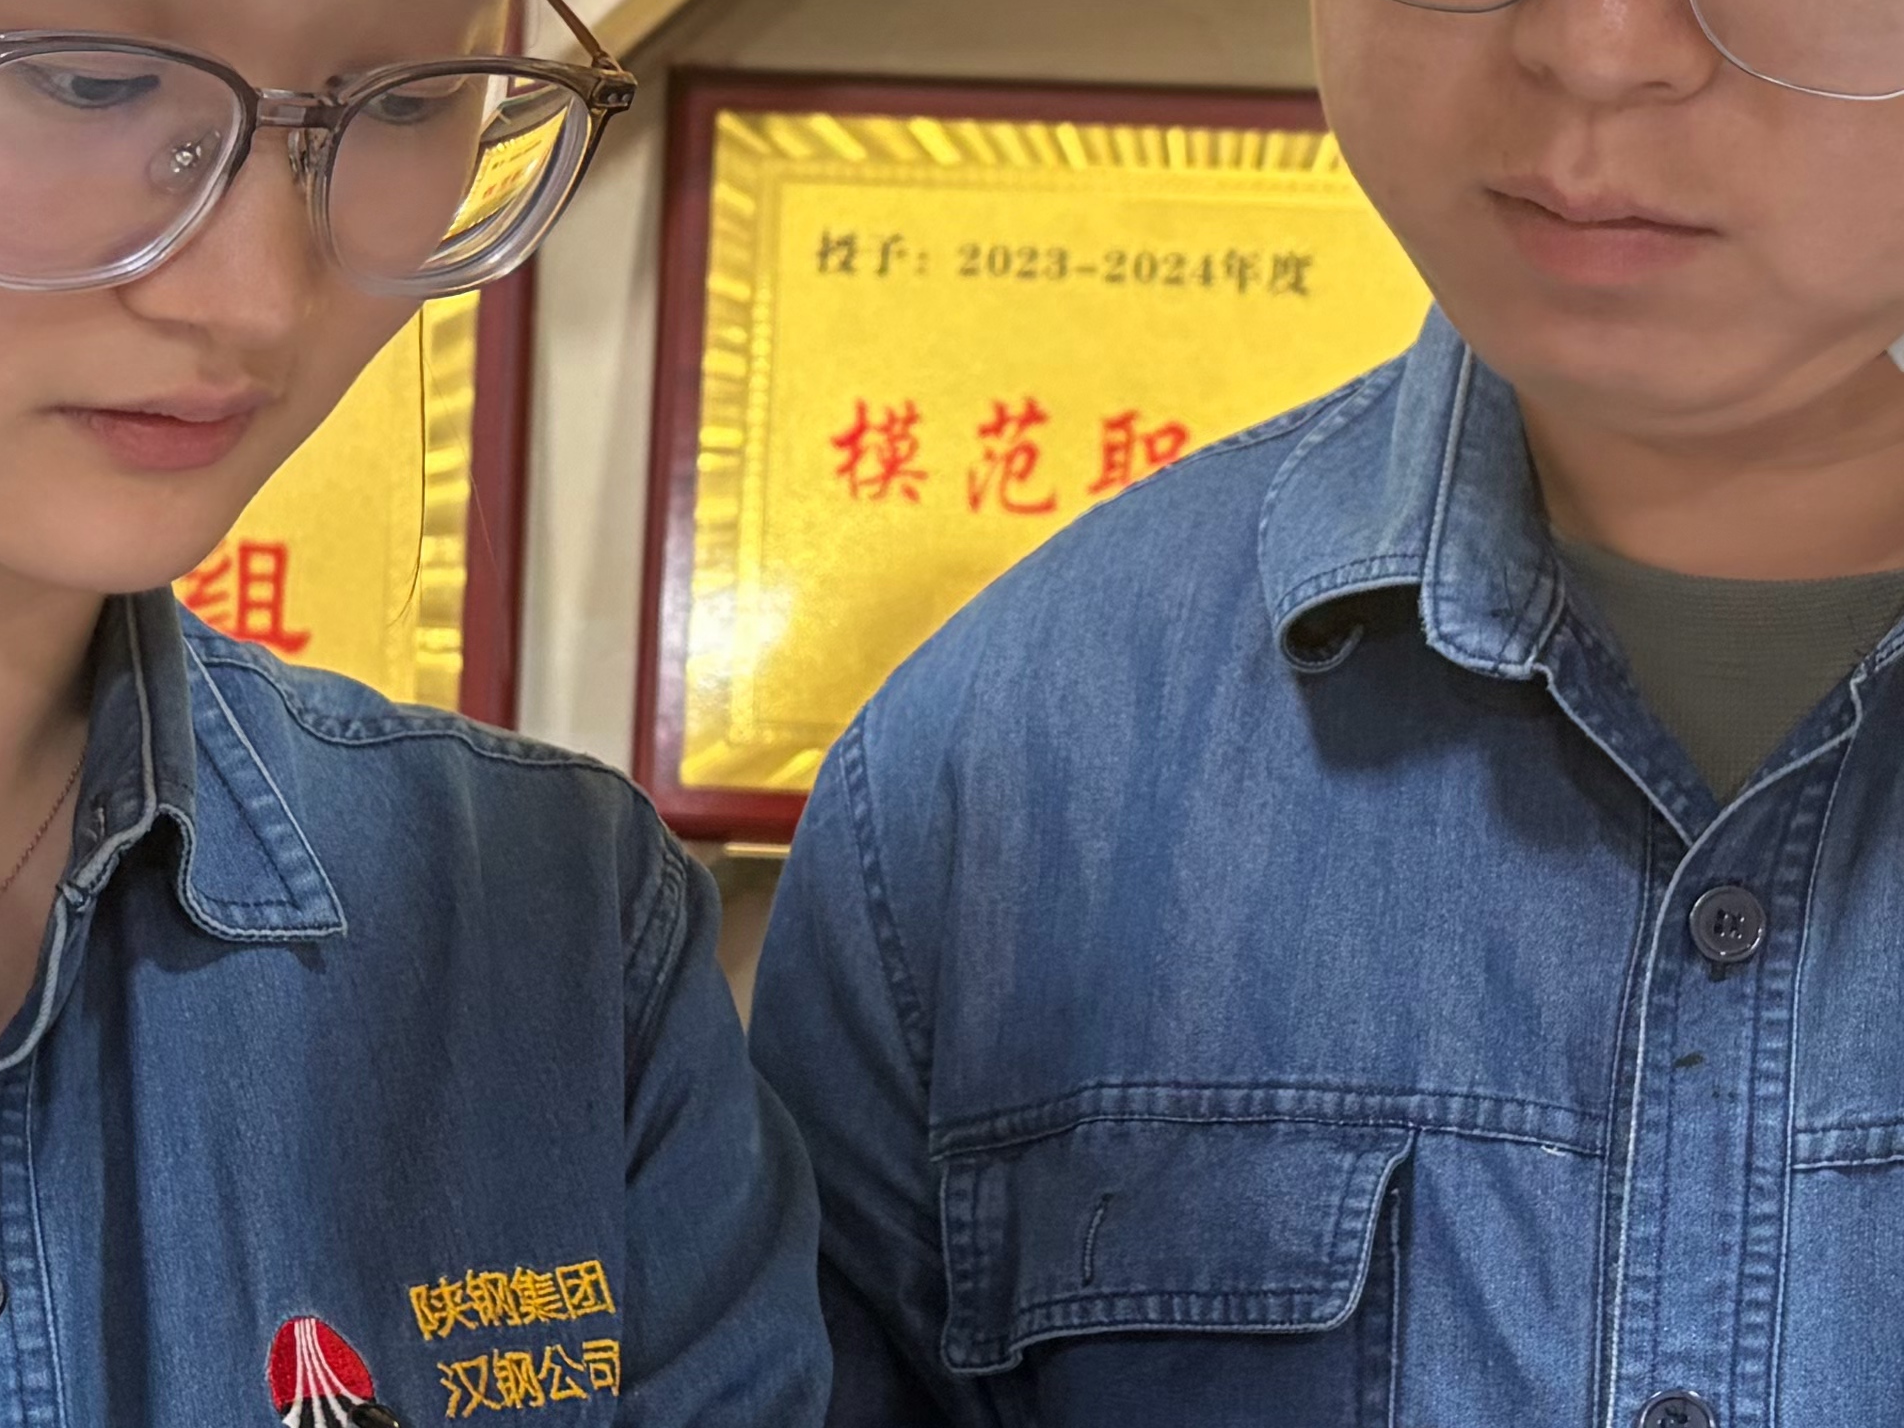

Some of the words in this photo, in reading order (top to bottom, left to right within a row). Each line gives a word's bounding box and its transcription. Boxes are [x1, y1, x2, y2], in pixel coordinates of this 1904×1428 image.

[409, 1260, 616, 1341] 陕钢集团
[437, 1338, 621, 1419] 汉钢公司
